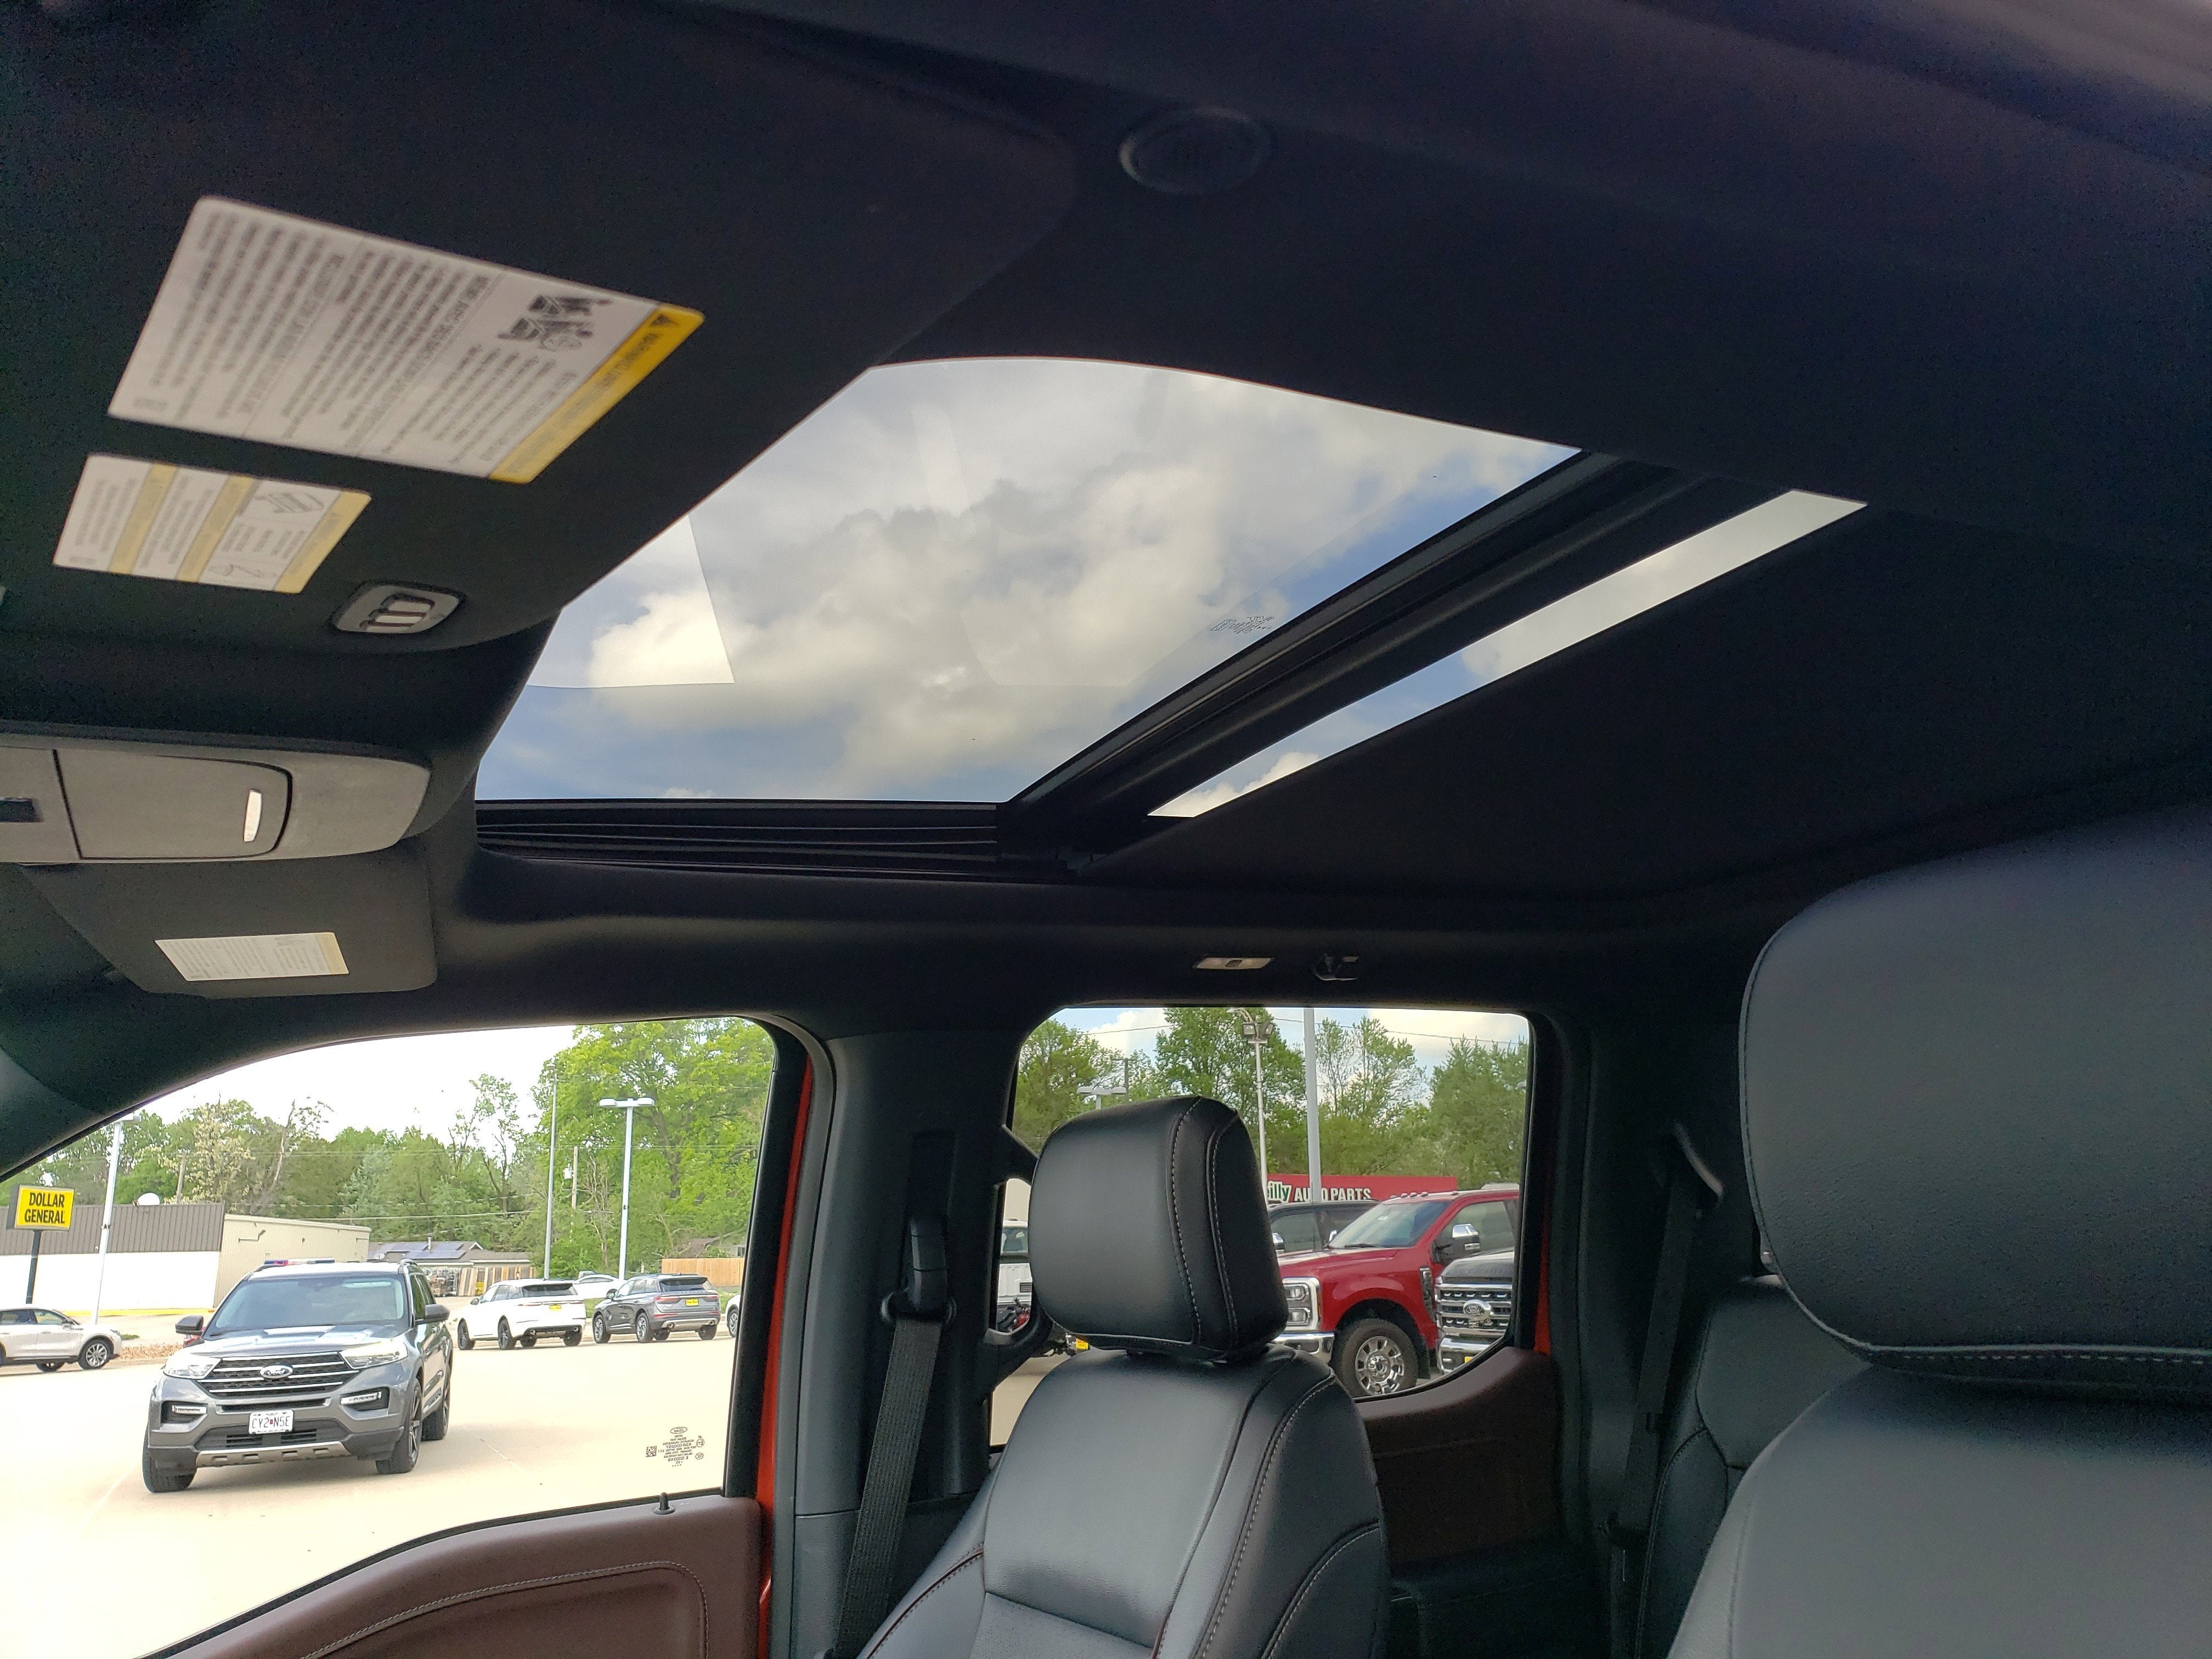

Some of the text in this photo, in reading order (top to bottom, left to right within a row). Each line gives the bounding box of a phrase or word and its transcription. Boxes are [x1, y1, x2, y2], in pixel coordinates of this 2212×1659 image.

[29, 1192, 65, 1208] DOLLAR
[1294, 1187, 1328, 1202] AUO
[1330, 1187, 1372, 1201] PARTS
[24, 1209, 65, 1224] GENERAL
